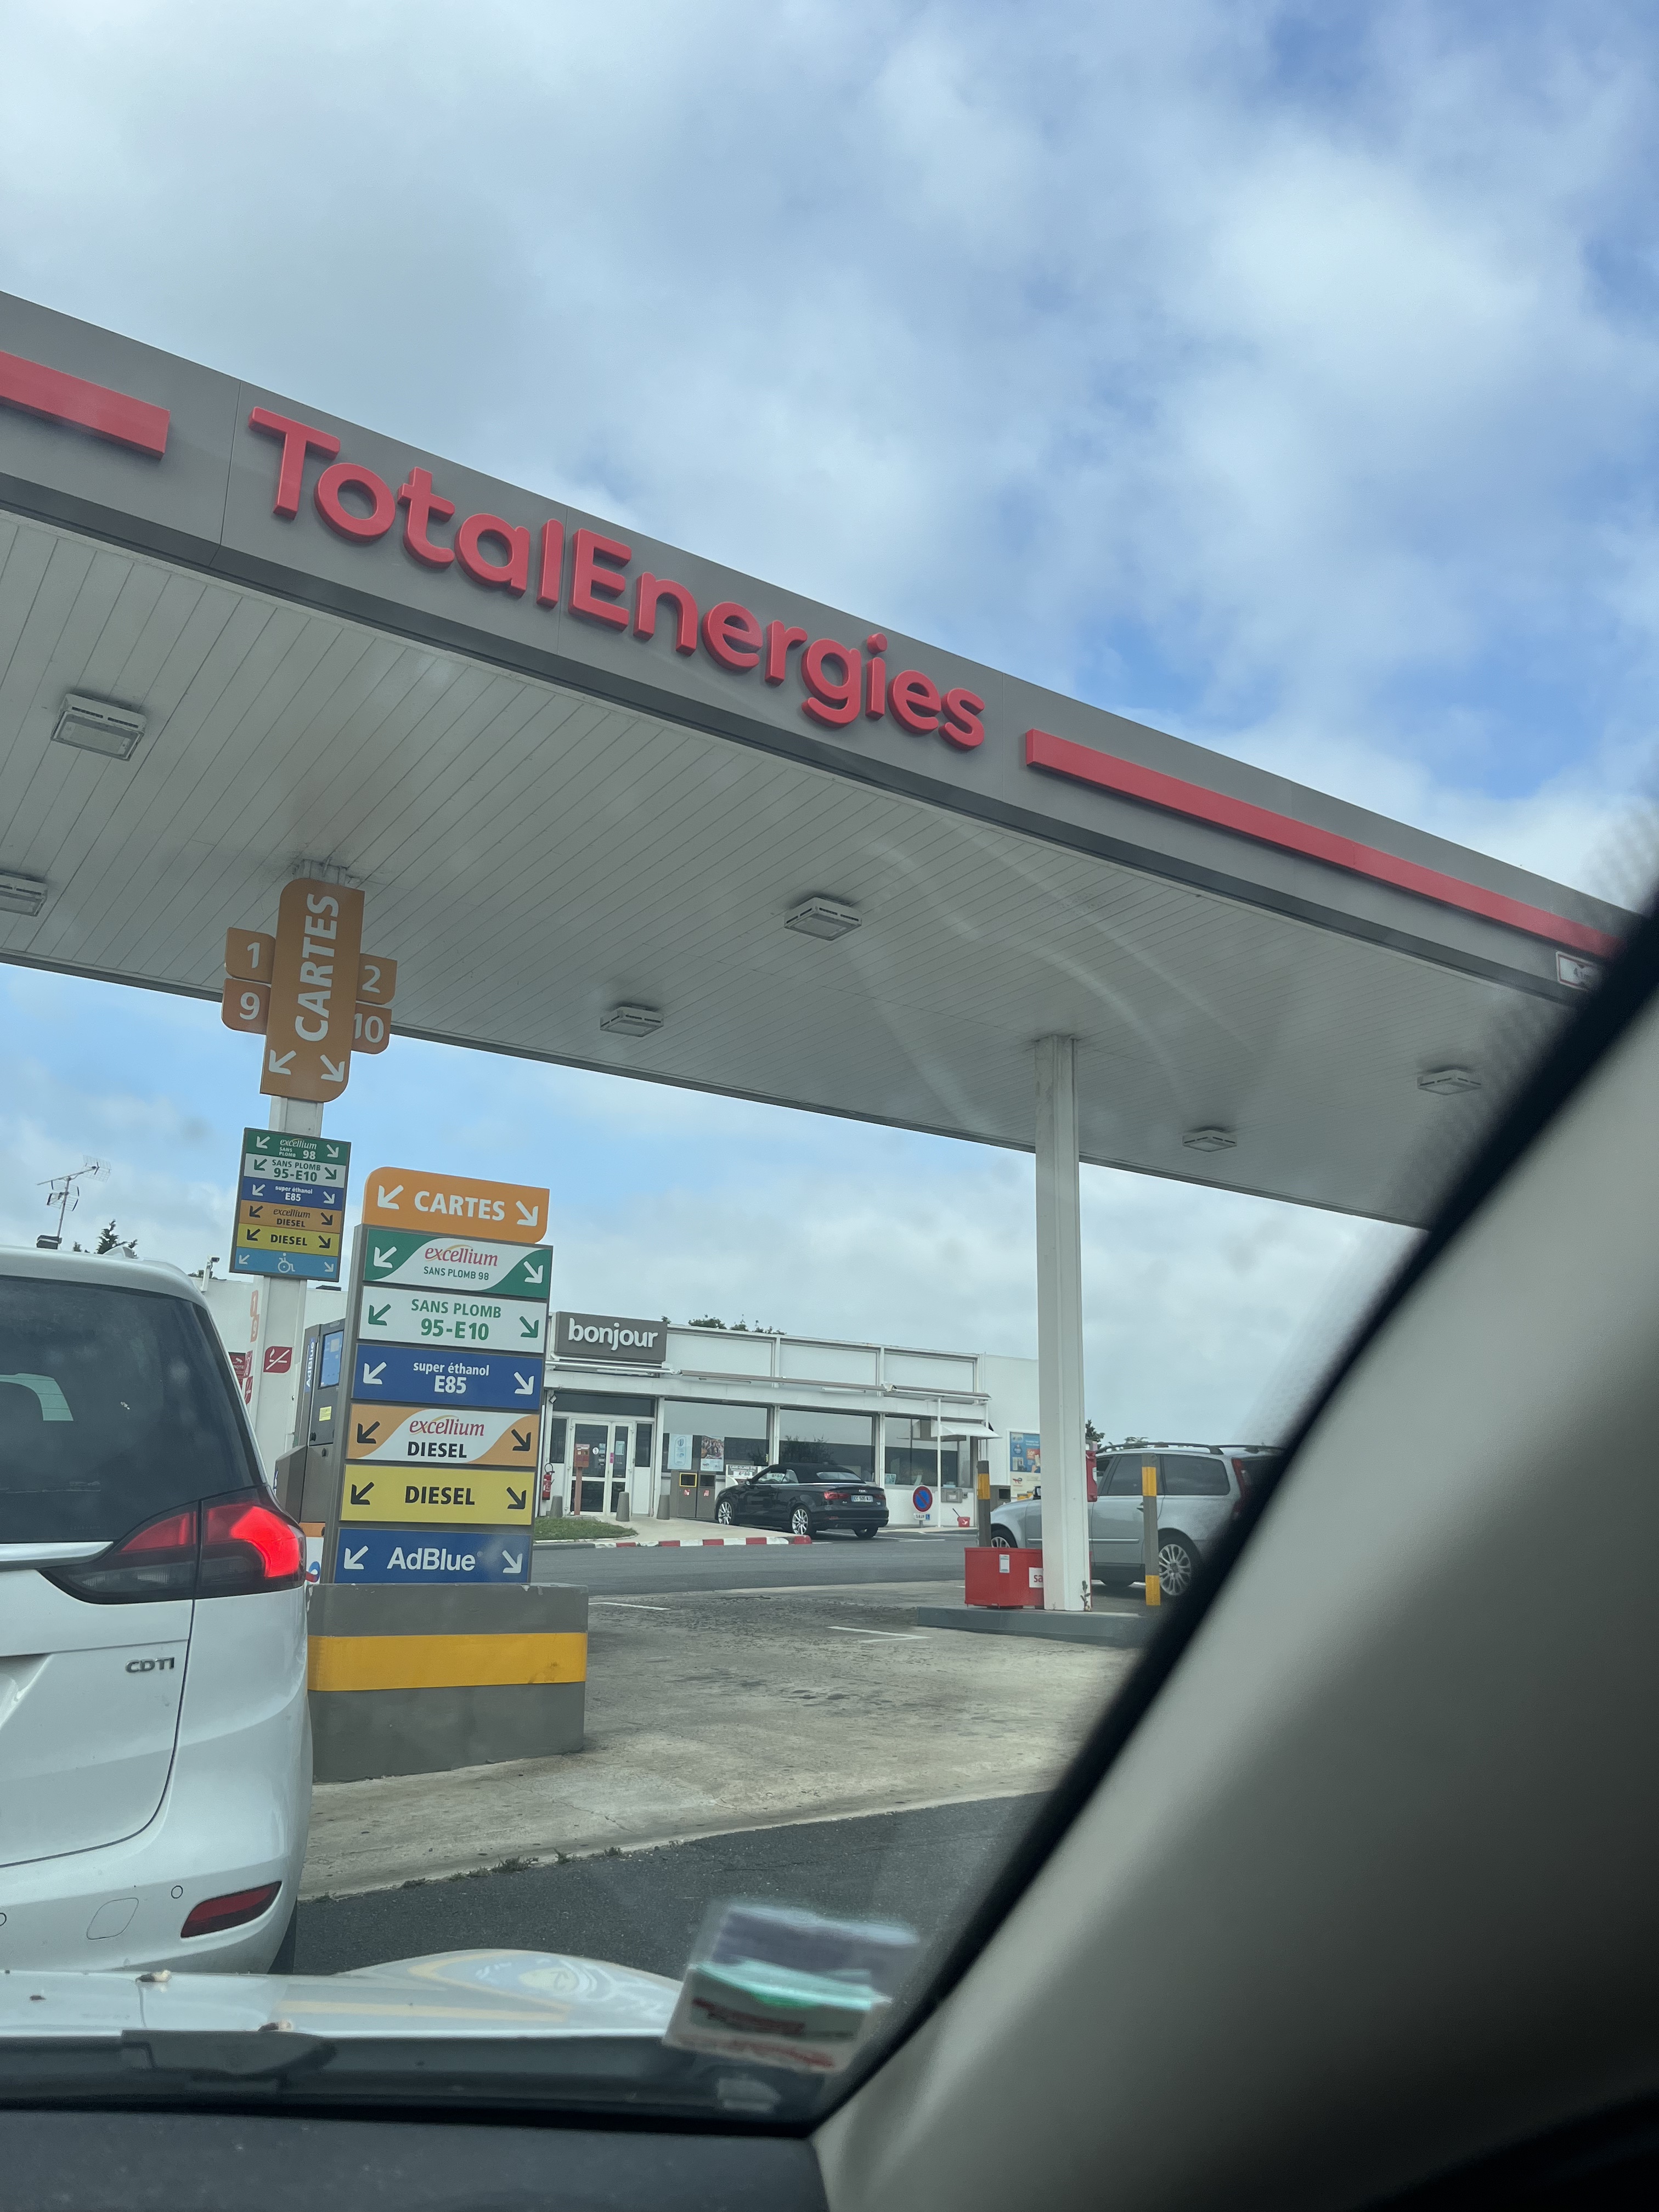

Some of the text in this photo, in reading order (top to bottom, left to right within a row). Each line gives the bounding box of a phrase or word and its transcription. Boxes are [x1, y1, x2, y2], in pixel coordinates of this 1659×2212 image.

[248, 406, 985, 750] TotalEnergies
[247, 942, 260, 968] 1
[295, 893, 339, 1042] CARTES
[362, 965, 381, 994] 2
[240, 992, 260, 1020] 9
[354, 1013, 384, 1043] 10
[280, 1138, 317, 1150] excellium
[302, 1150, 316, 1160] 98
[272, 1159, 321, 1171] SANS PLOMB
[274, 1168, 318, 1182] 95-E10
[285, 1192, 301, 1201] E85
[414, 1190, 505, 1221] CARTES
[273, 1207, 311, 1219] excellium
[276, 1218, 306, 1228] DIESEL
[270, 1234, 308, 1246] DIESEL
[425, 1246, 498, 1267] excellium
[424, 1266, 489, 1280] SANS PLOMB 98
[411, 1299, 501, 1319] SANS PLOMB
[421, 1318, 489, 1340] 95-E10
[568, 1317, 658, 1351] bonjour
[413, 1362, 489, 1376] super éthanol
[434, 1375, 467, 1394] E85
[409, 1418, 484, 1436] excellium
[407, 1441, 467, 1458] DIESEL
[405, 1486, 475, 1505] DIESEL
[387, 1547, 476, 1571] AdBlue
